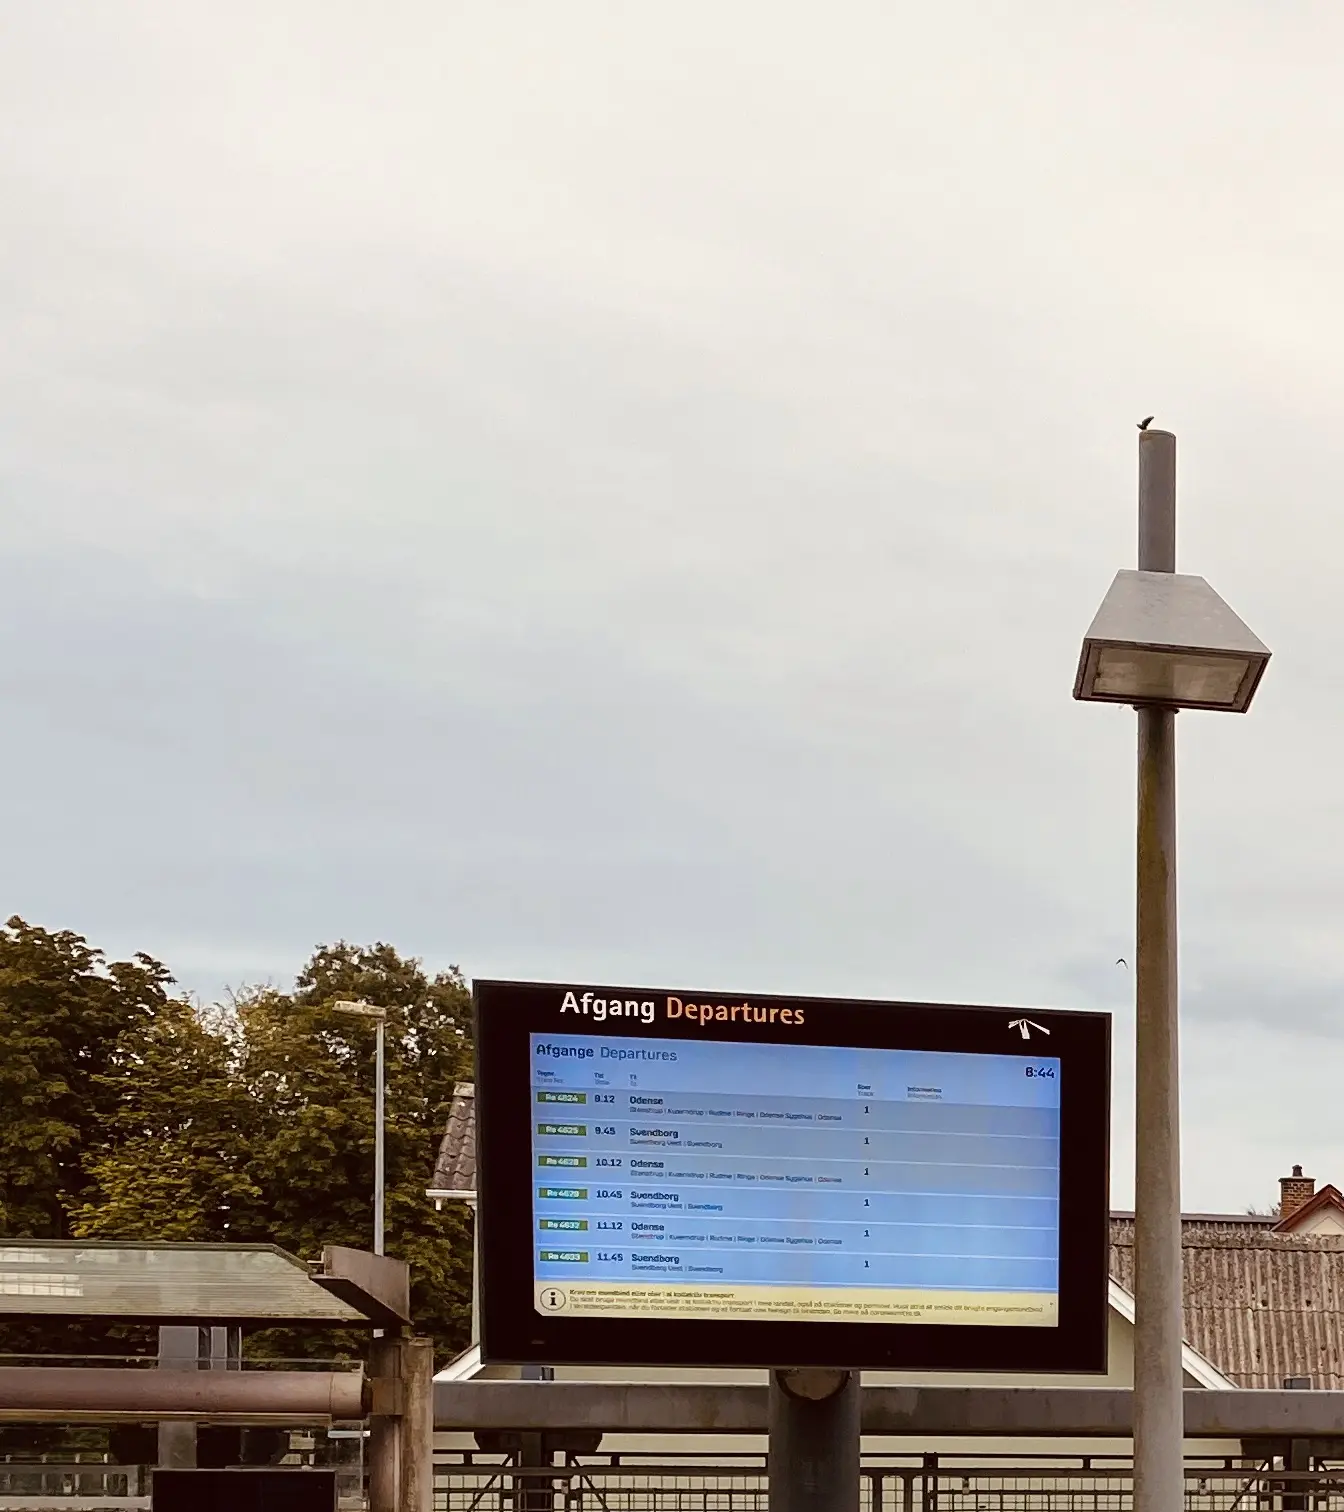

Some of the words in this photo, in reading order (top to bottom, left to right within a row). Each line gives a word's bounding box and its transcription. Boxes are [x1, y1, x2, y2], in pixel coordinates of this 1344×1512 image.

[560, 992, 655, 1023] Afgang
[667, 997, 804, 1025] Departures
[536, 1044, 594, 1059] Afgange
[600, 1046, 677, 1061] Departures
[1025, 1067, 1055, 1078] 8:44
[629, 1096, 663, 1105] Odense
[864, 1106, 870, 1114] 1
[864, 1137, 870, 1145] 1
[596, 1159, 622, 1167] 10.12
[630, 1159, 664, 1168] Odense
[864, 1168, 870, 1176] 1
[596, 1190, 623, 1199] 10.45
[864, 1199, 870, 1207] 1
[597, 1222, 623, 1230] 11.12
[631, 1222, 665, 1231] Odense
[864, 1229, 870, 1237] 1
[597, 1252, 623, 1261] 11.45
[864, 1260, 870, 1268] 1
